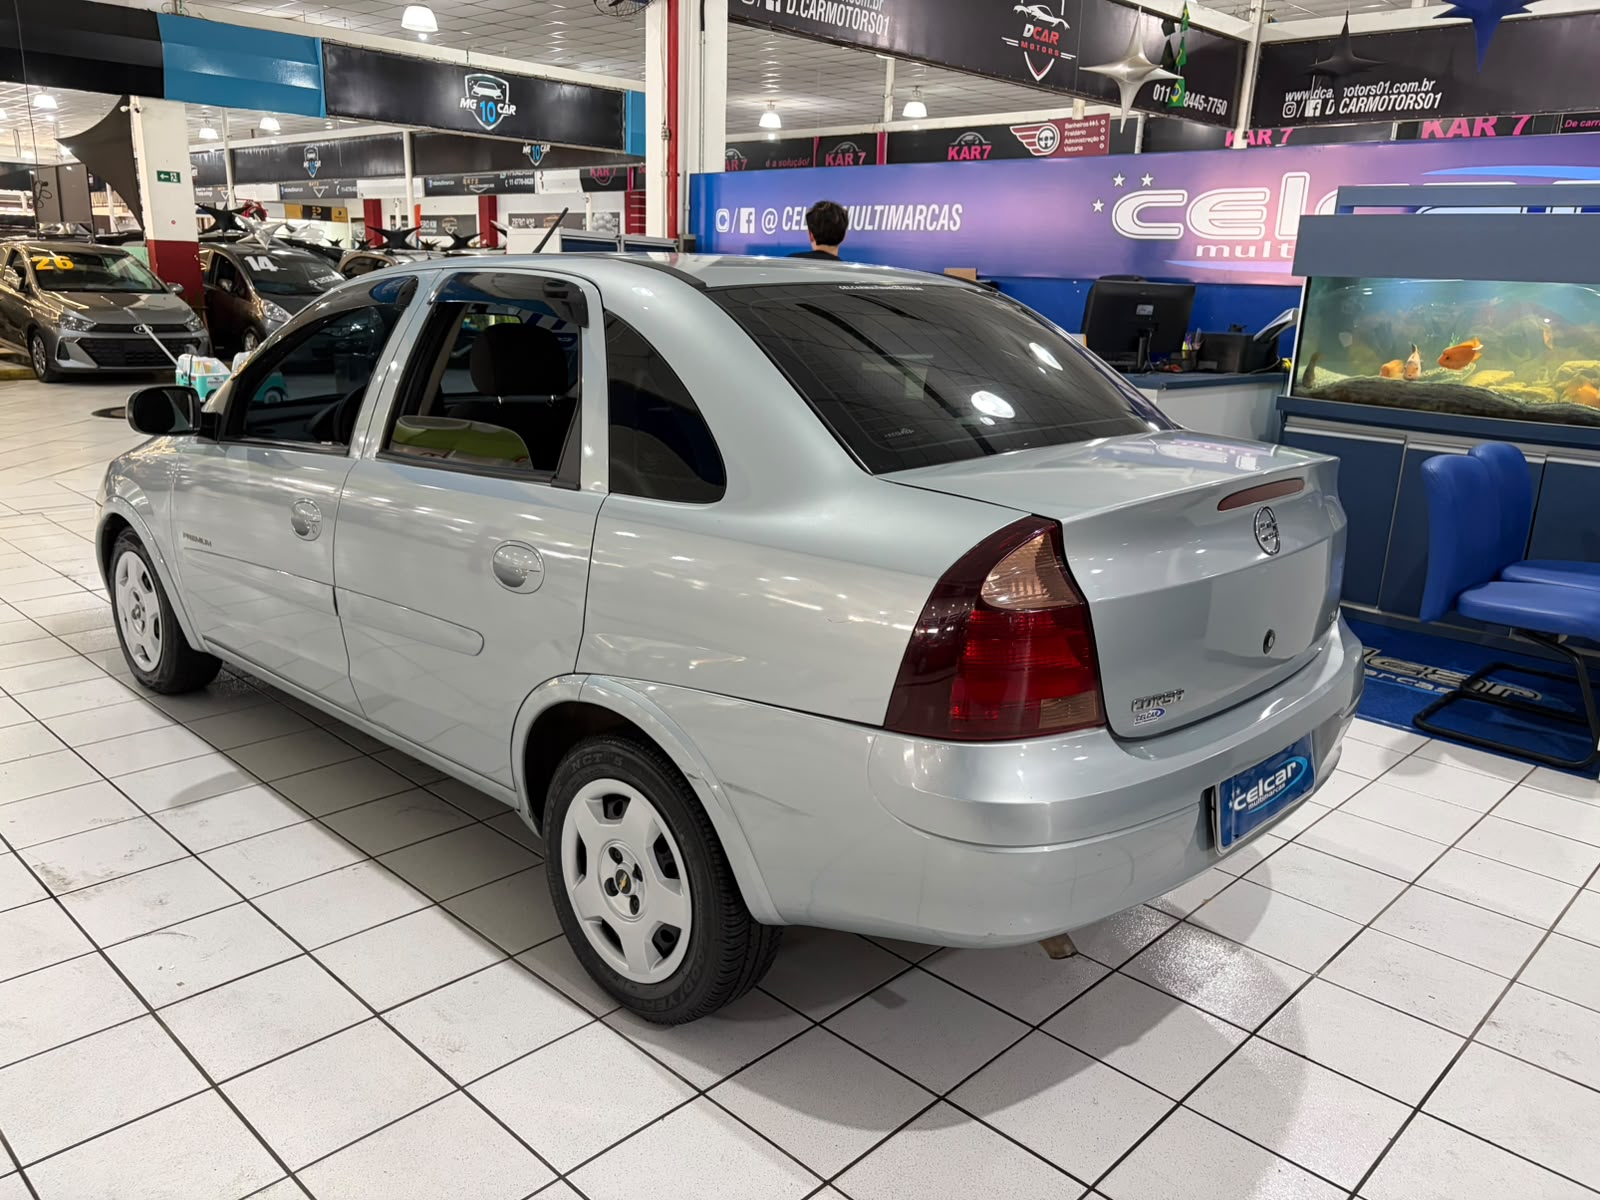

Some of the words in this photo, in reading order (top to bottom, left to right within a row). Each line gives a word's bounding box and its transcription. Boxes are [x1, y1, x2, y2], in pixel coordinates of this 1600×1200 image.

[786, 0, 890, 36] D.CARMOTORS01
[1022, 23, 1060, 46] DCAR
[1020, 40, 1060, 57] MOTORS
[460, 97, 477, 109] MG
[480, 100, 496, 123] 10
[497, 103, 517, 115] CAR
[1153, 84, 1170, 103] 011
[1183, 93, 1228, 116] 8445-7750
[1325, 92, 1442, 115] DCARMOTORS01
[1421, 115, 1498, 139] KAR
[1512, 114, 1533, 136] 7
[725, 159, 739, 171] AR
[825, 153, 853, 167] KAR
[858, 152, 867, 165] 7
[31, 256, 75, 271] 26
[245, 255, 279, 272] 14
[183, 532, 212, 547] PREMIUM
[1131, 689, 1185, 713] CORSA
[1233, 761, 1297, 811] celcar
